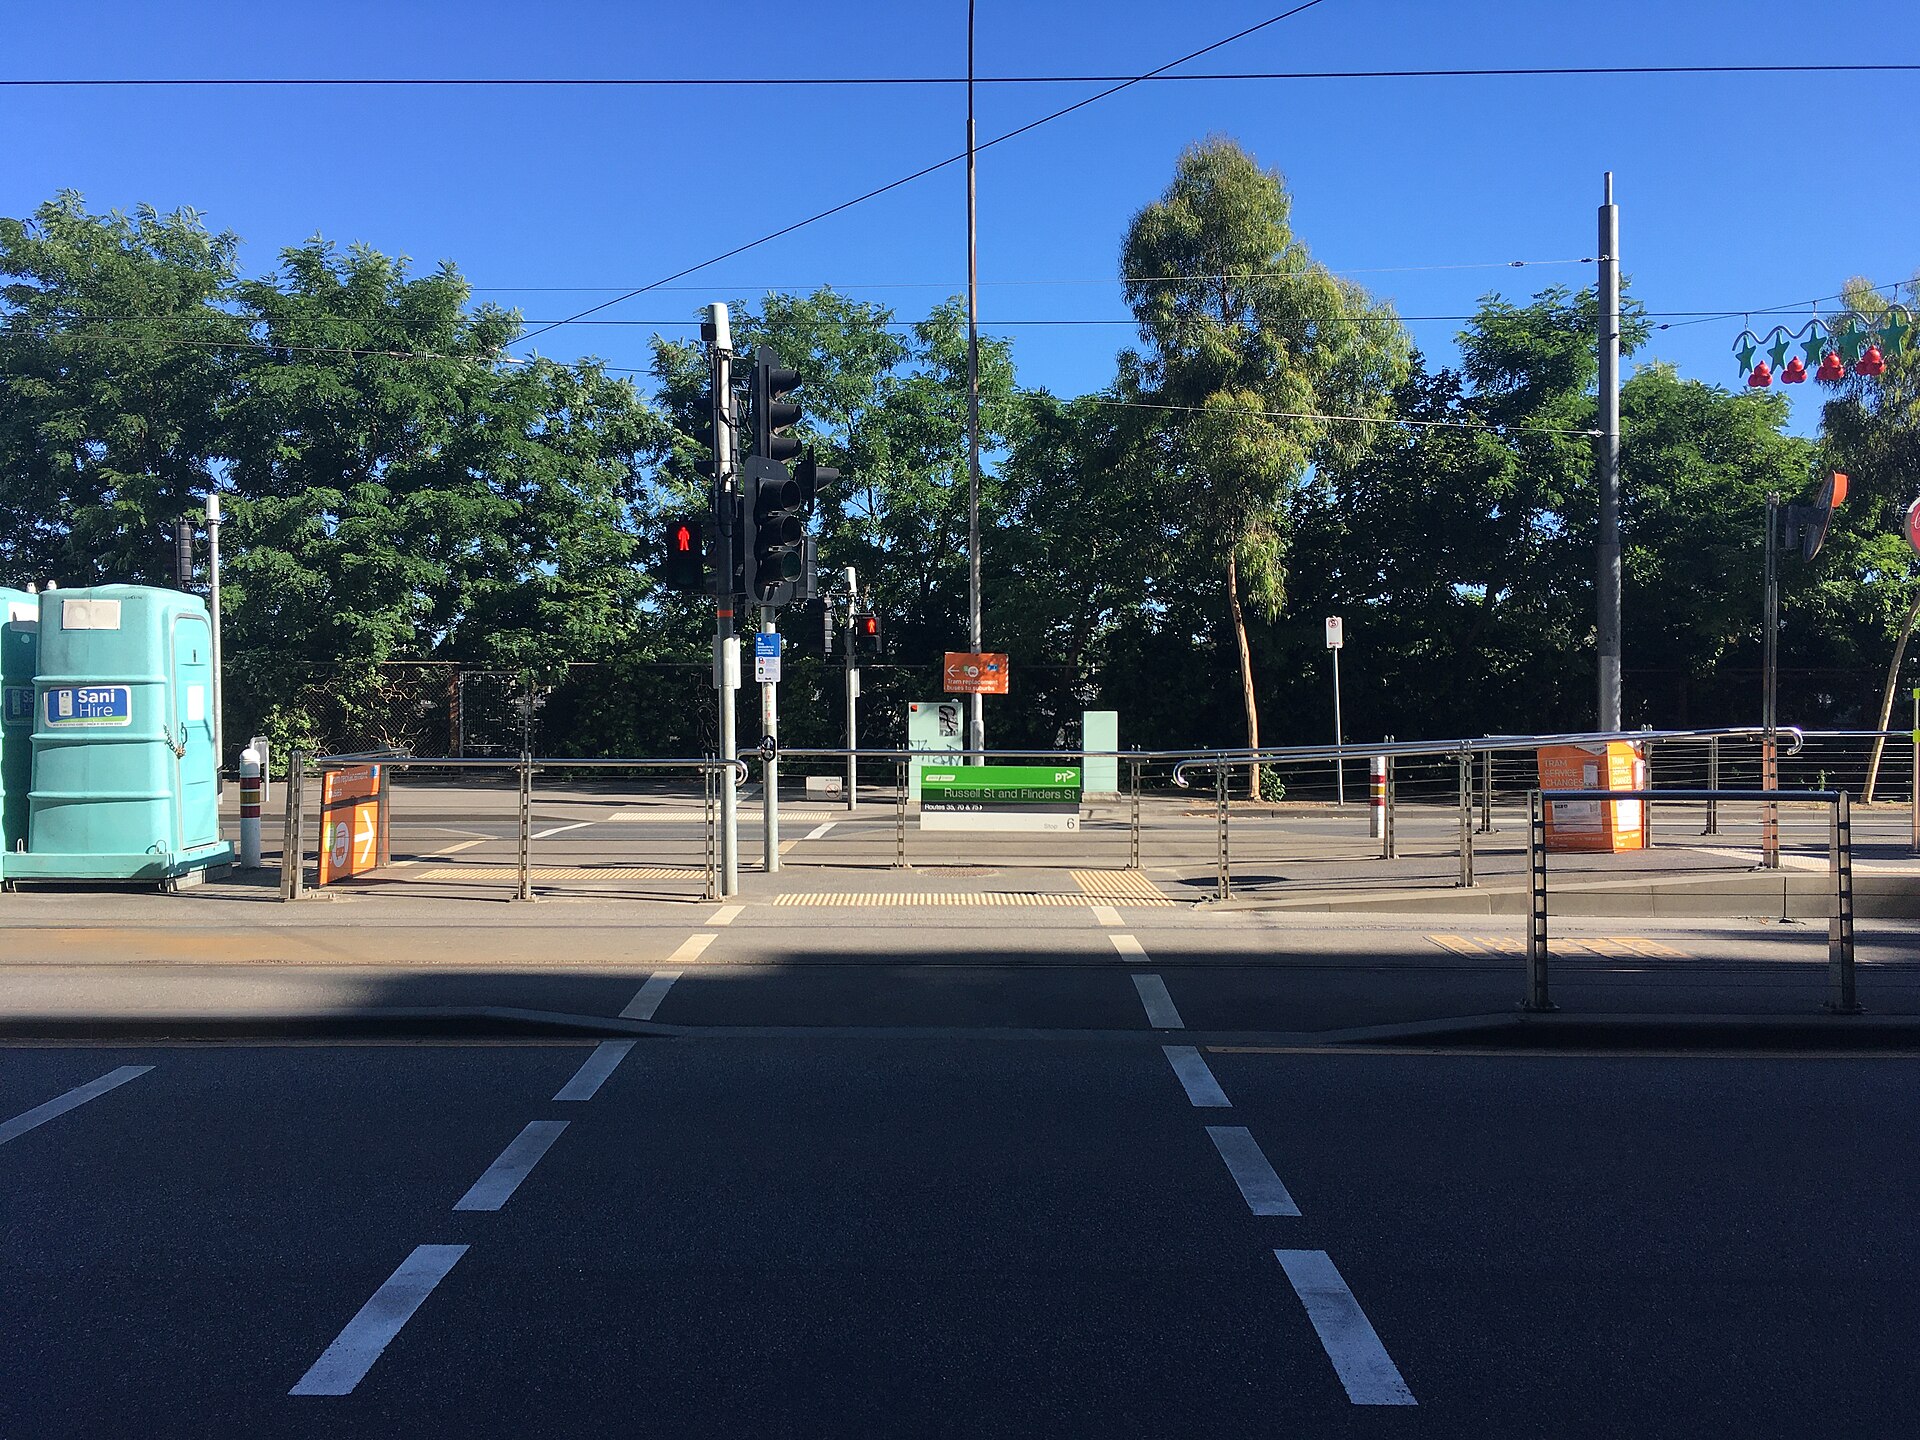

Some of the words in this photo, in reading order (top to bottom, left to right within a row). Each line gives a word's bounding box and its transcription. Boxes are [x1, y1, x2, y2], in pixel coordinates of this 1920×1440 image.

[23, 690, 34, 703] Sa
[77, 688, 115, 704] Sani
[79, 704, 114, 717] Hire
[1544, 759, 1568, 768] TRAM
[1544, 768, 1578, 777] SERVICE
[1545, 778, 1584, 787] CHANGES
[944, 787, 980, 798] Russell
[983, 788, 995, 798] St
[998, 789, 1018, 799] and
[1021, 788, 1061, 799] Flinders
[1063, 789, 1076, 800] St
[924, 803, 945, 811] Routes
[1066, 817, 1075, 830] 6
